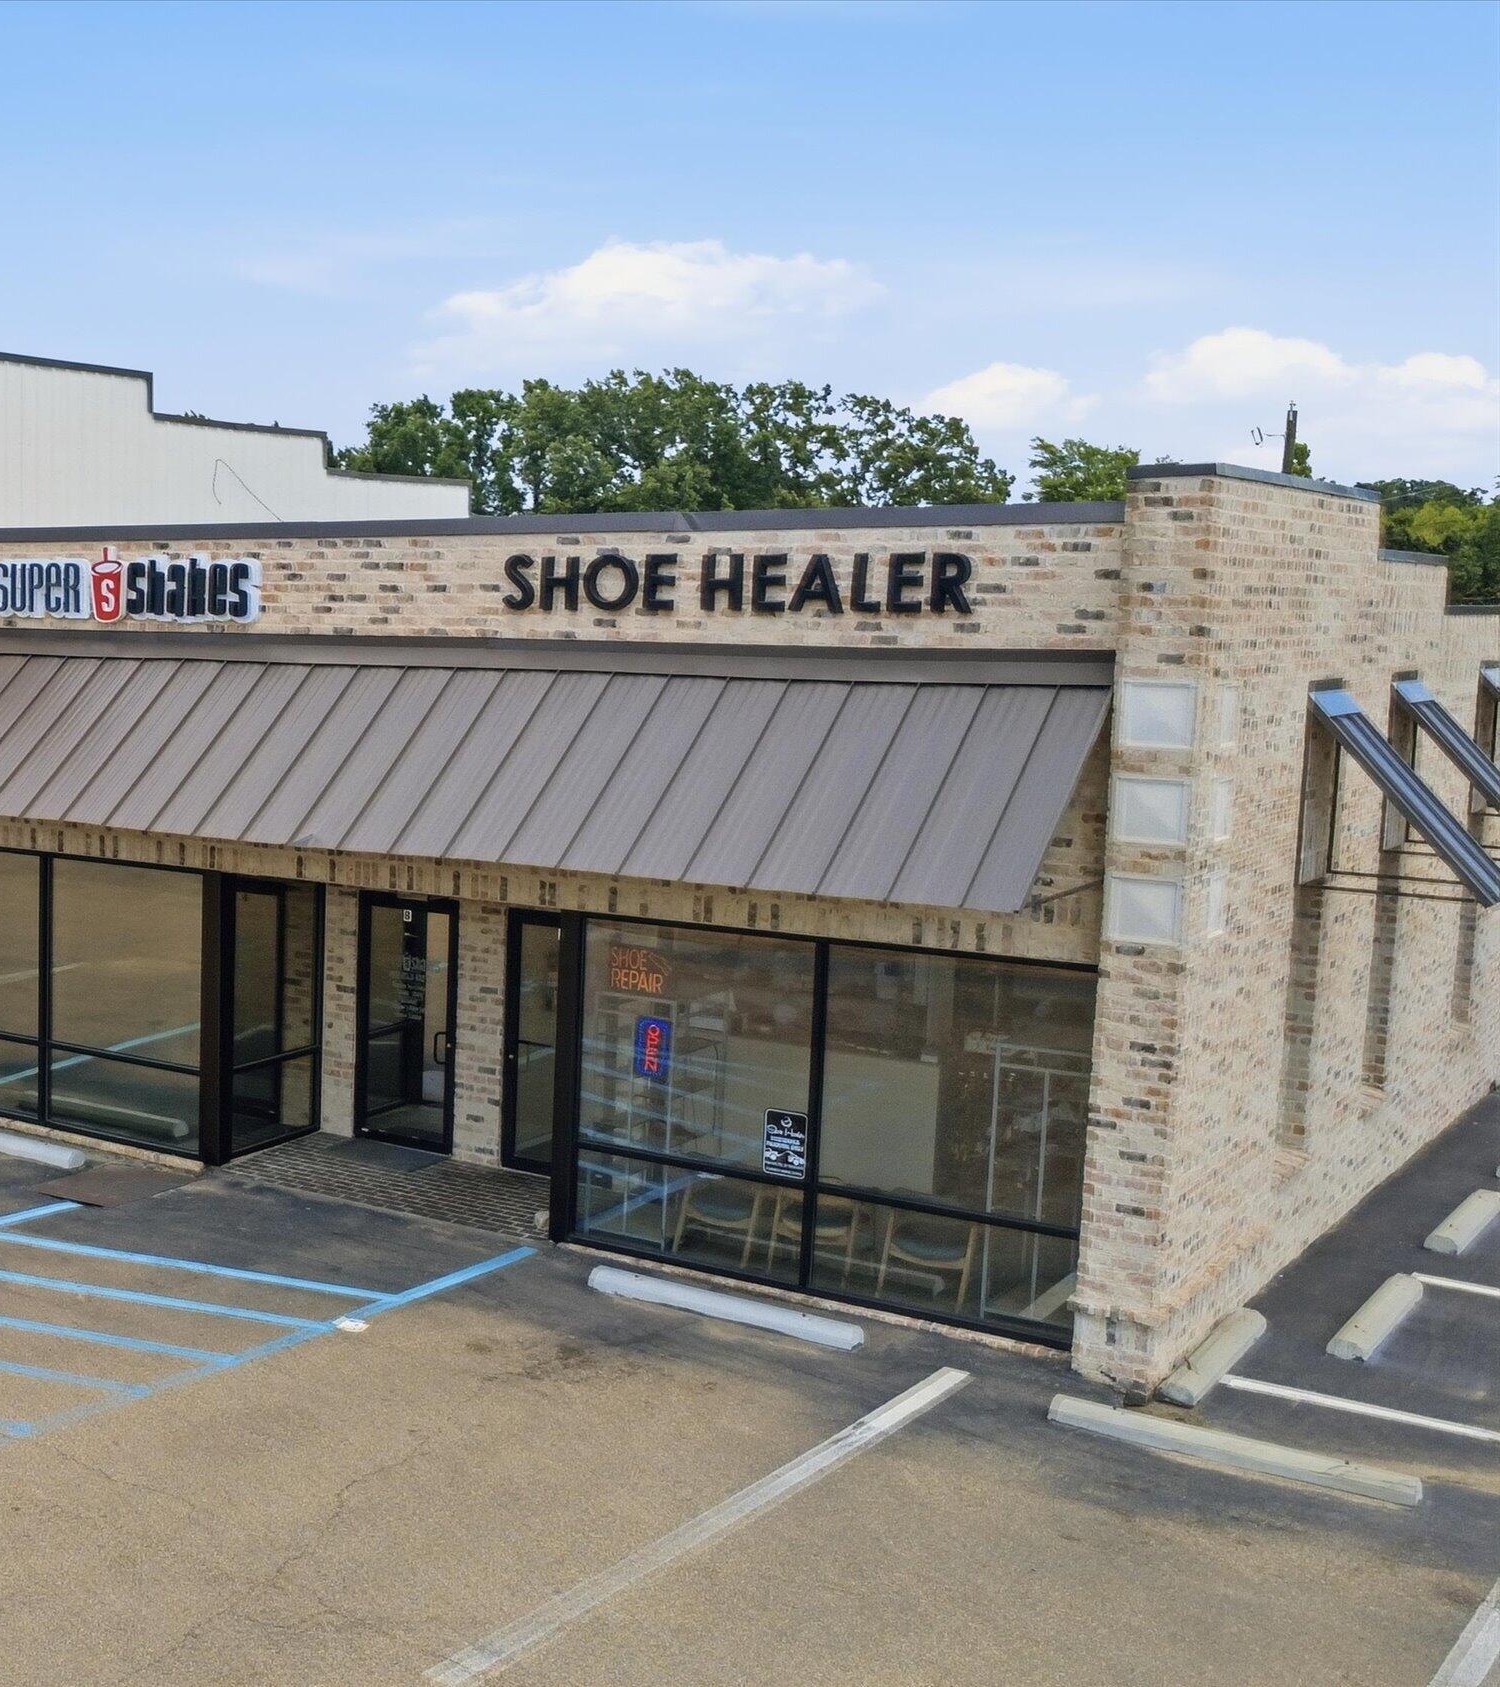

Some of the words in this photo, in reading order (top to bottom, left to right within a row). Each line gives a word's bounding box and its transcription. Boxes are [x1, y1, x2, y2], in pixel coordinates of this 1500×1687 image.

[502, 552, 678, 612] SHOE
[700, 550, 974, 615] HEALER
[611, 946, 648, 971] SHOE
[610, 967, 664, 994] REPAIR
